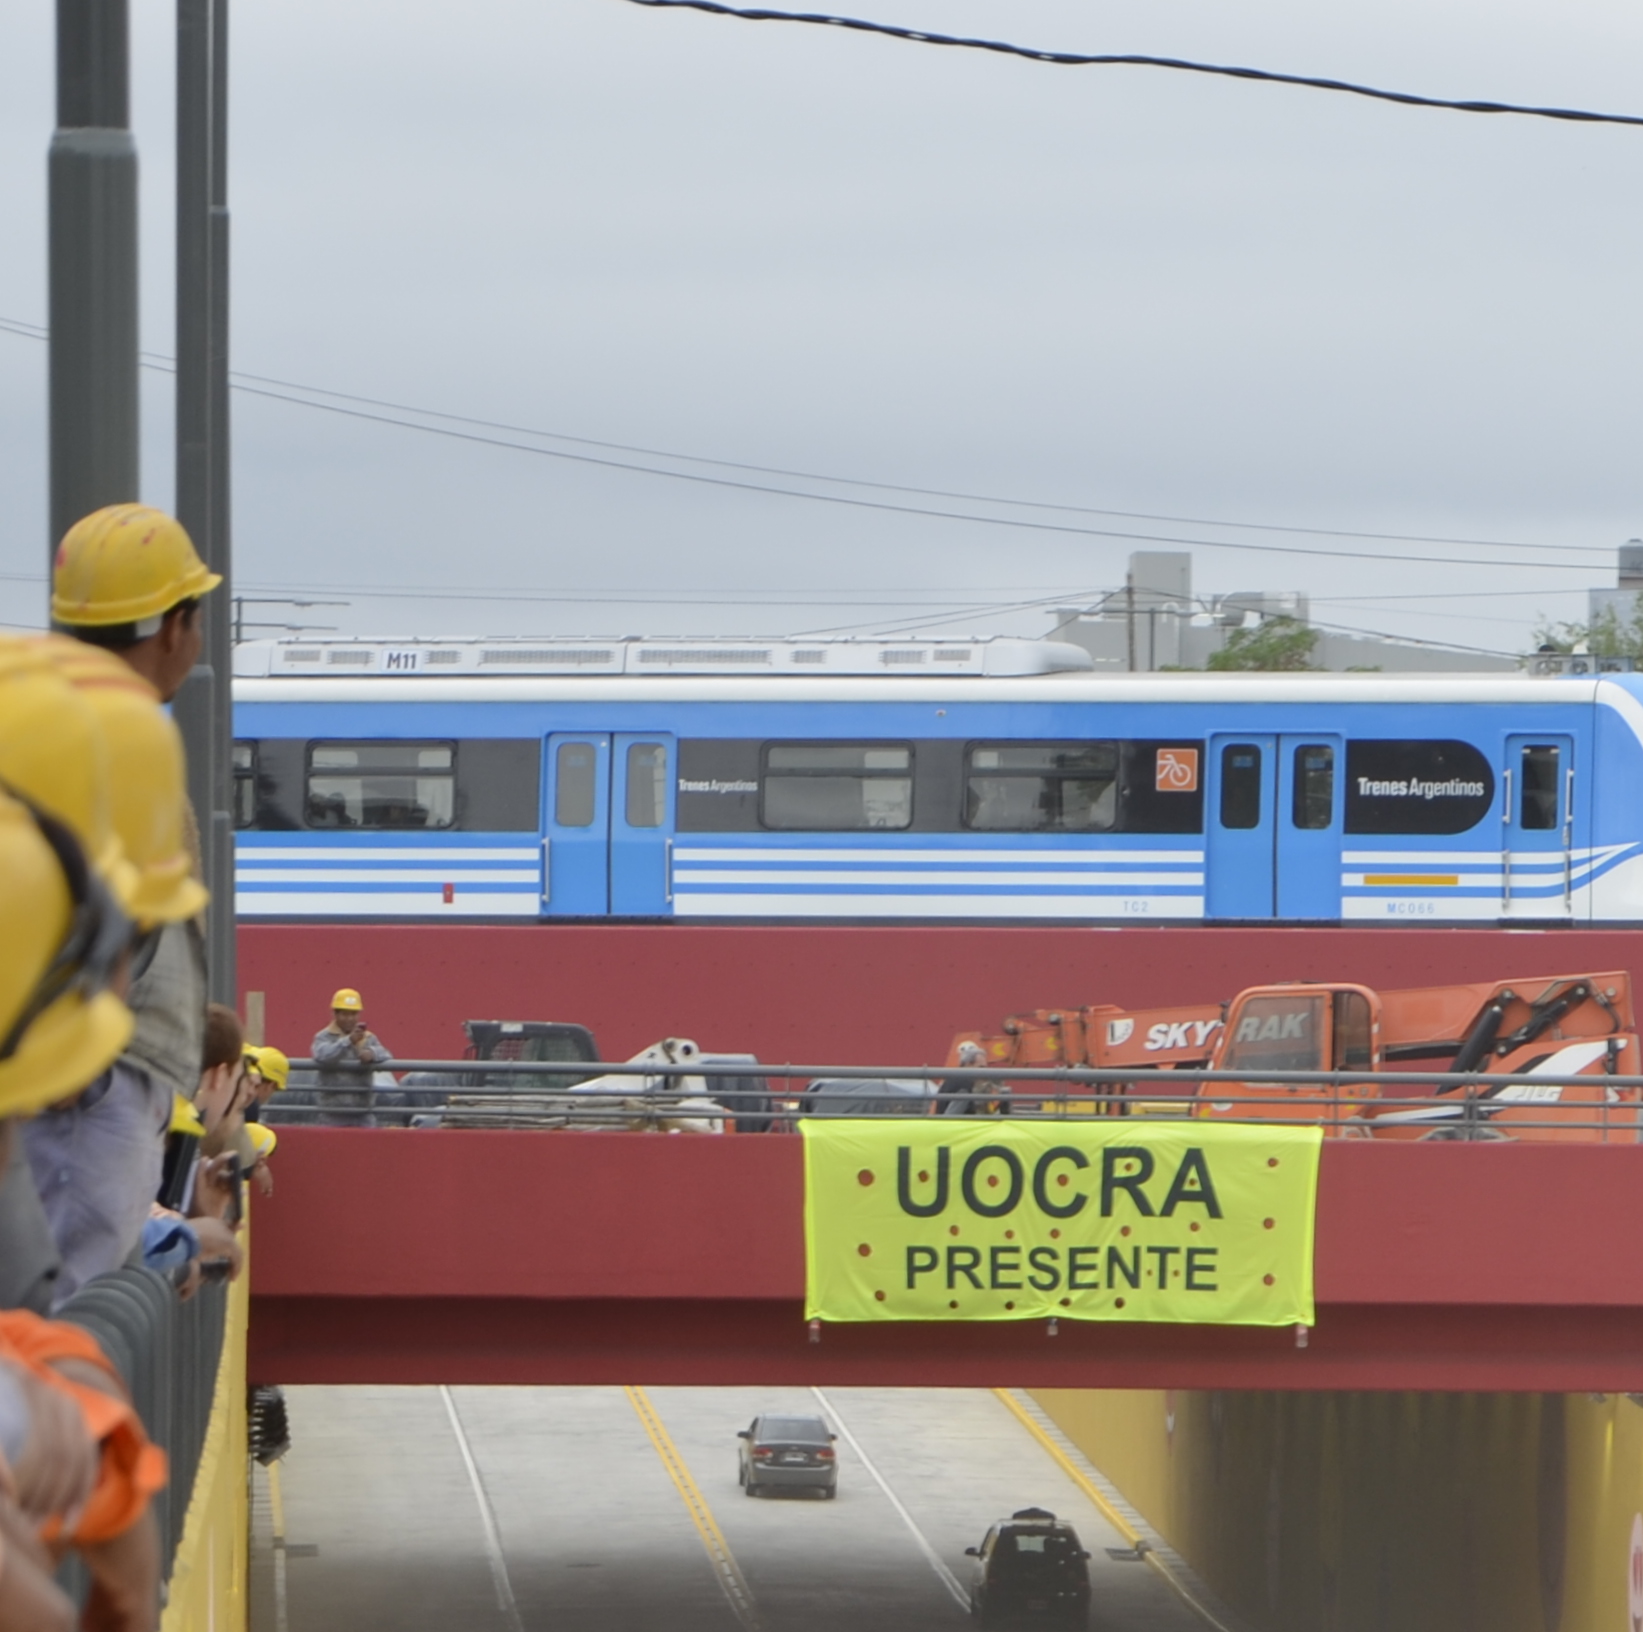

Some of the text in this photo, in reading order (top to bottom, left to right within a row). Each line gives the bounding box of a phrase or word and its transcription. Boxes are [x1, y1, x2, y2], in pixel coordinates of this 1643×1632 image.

[387, 652, 417, 669] M11
[1358, 777, 1484, 799] Trenes Argentinos
[898, 1145, 1223, 1219] UOCRA
[906, 1246, 1219, 1291] PRESENTE
